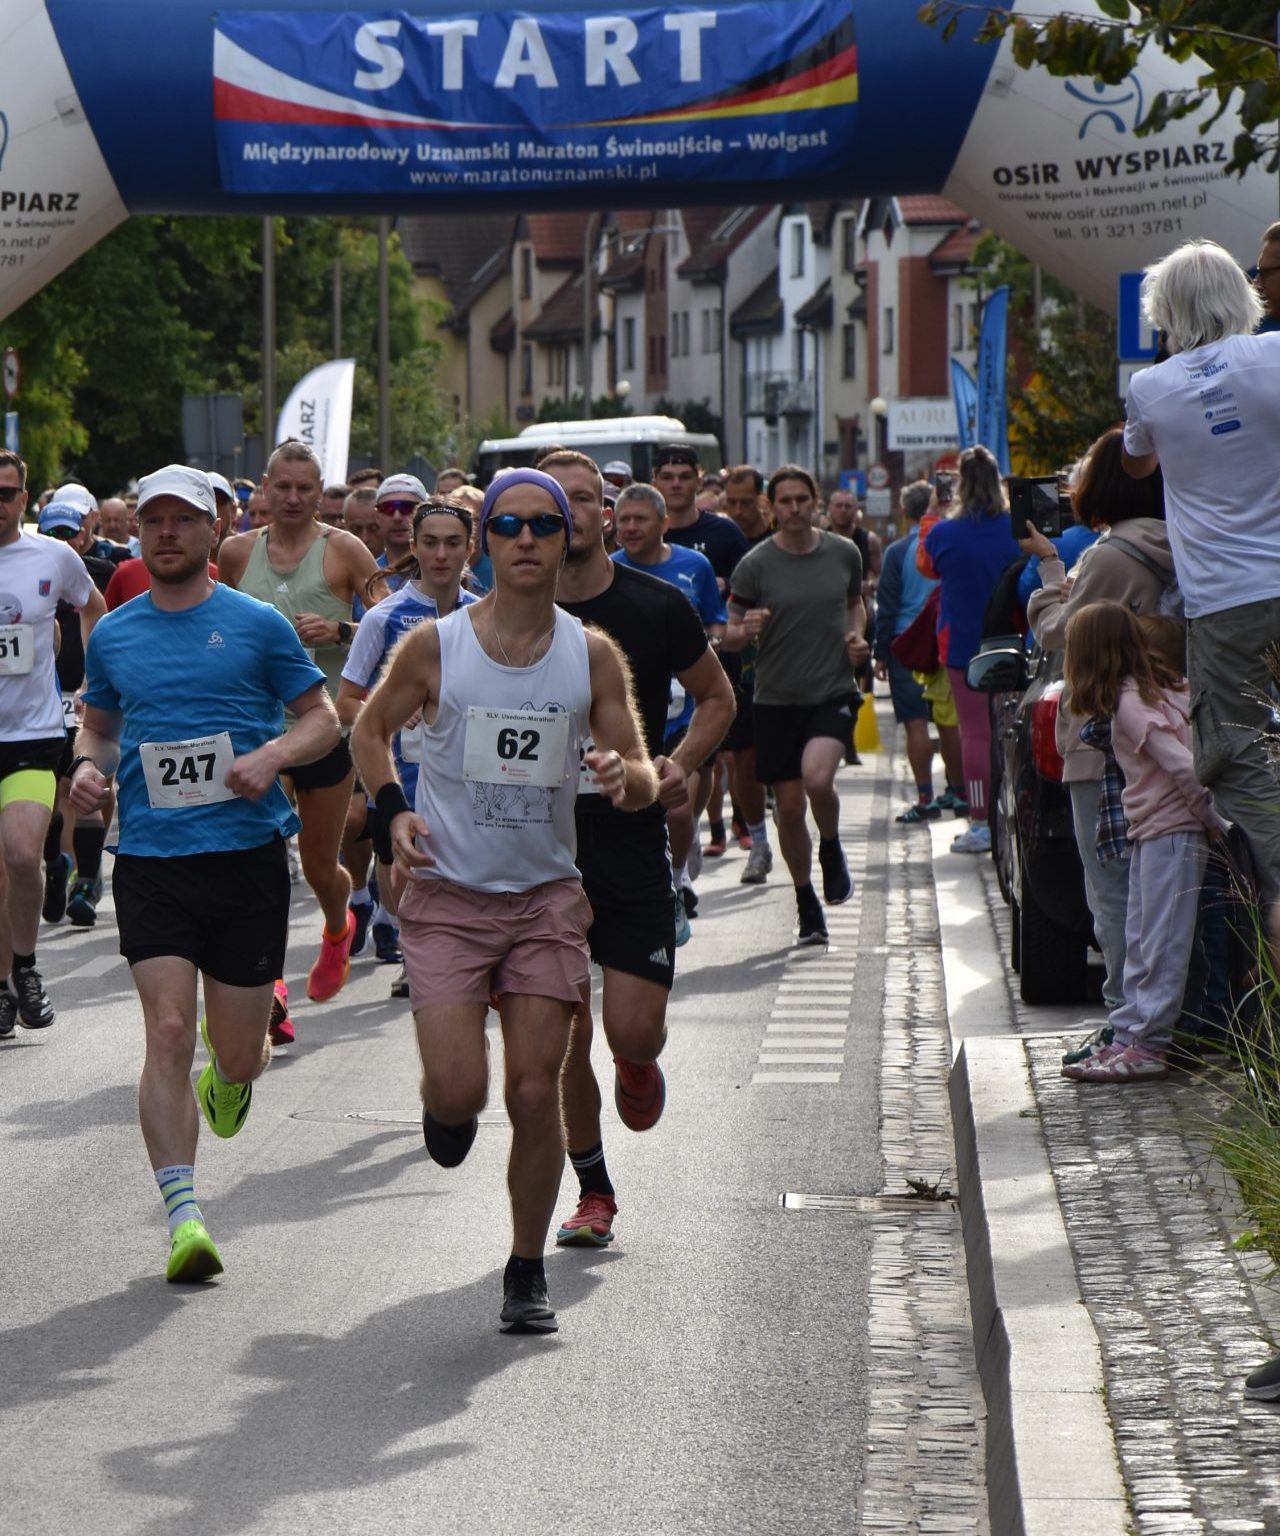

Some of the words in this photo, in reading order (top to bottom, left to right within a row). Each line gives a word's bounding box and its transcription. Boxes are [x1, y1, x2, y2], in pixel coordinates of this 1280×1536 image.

[353, 11, 717, 91] START
[243, 142, 410, 165] Międzynarodowy
[417, 142, 510, 161] Uznamski
[517, 140, 599, 160] Maraton
[606, 136, 723, 159] Świnoujście
[747, 129, 827, 152] Wolgast
[410, 162, 658, 185] www.maratonuznamski.pl
[993, 162, 1061, 187] OSiR
[1074, 142, 1228, 181] WYSPIARZ
[1025, 191, 1208, 222] www.osir.uznam.net.pl
[1044, 189, 1082, 202] Sportu
[1093, 182, 1146, 199] Rekreacji
[1150, 180, 1160, 191] w
[1053, 227, 1073, 241] tel.
[1081, 226, 1100, 240] 91
[1106, 223, 1135, 240] 321
[1141, 217, 1183, 237] 3781
[501, 713, 556, 723] Usedom-Marathon
[497, 728, 540, 761] 62
[158, 752, 216, 786] 247
